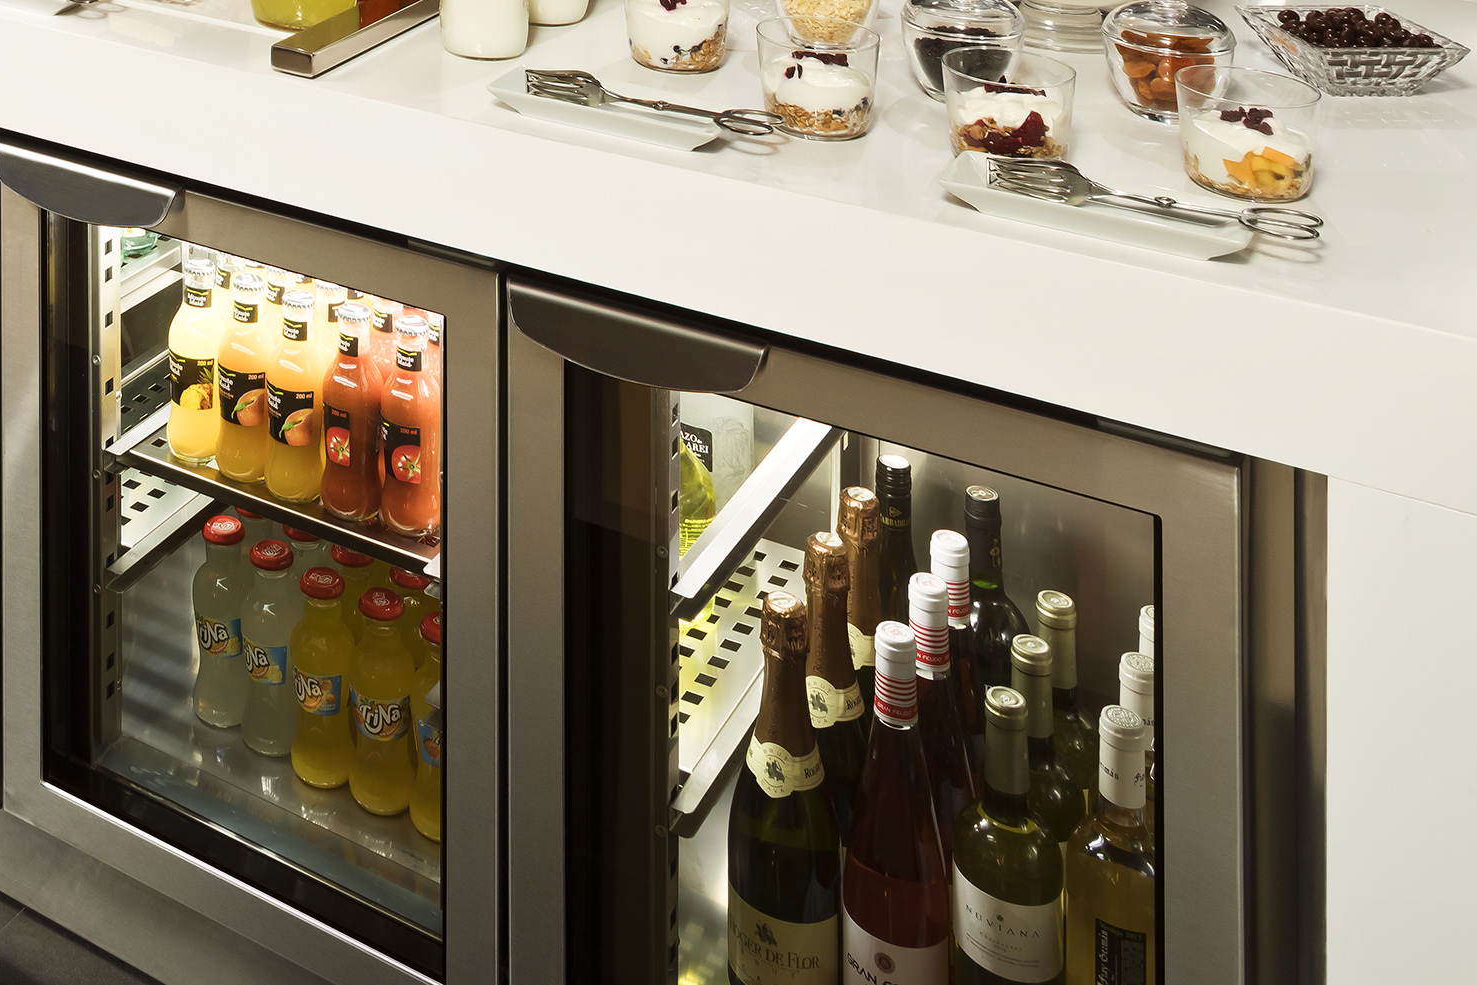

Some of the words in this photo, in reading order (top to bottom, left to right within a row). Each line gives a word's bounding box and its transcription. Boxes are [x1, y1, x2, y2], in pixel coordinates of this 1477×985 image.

[680, 430, 697, 443] AZO
[359, 704, 402, 735] TriNa
[763, 748, 788, 761] BRUT
[965, 904, 1040, 938] NUVIANA
[729, 913, 762, 958] ROGER
[765, 949, 784, 966] DE
[787, 951, 820, 969] FLOR
[847, 952, 877, 985] GRAN
